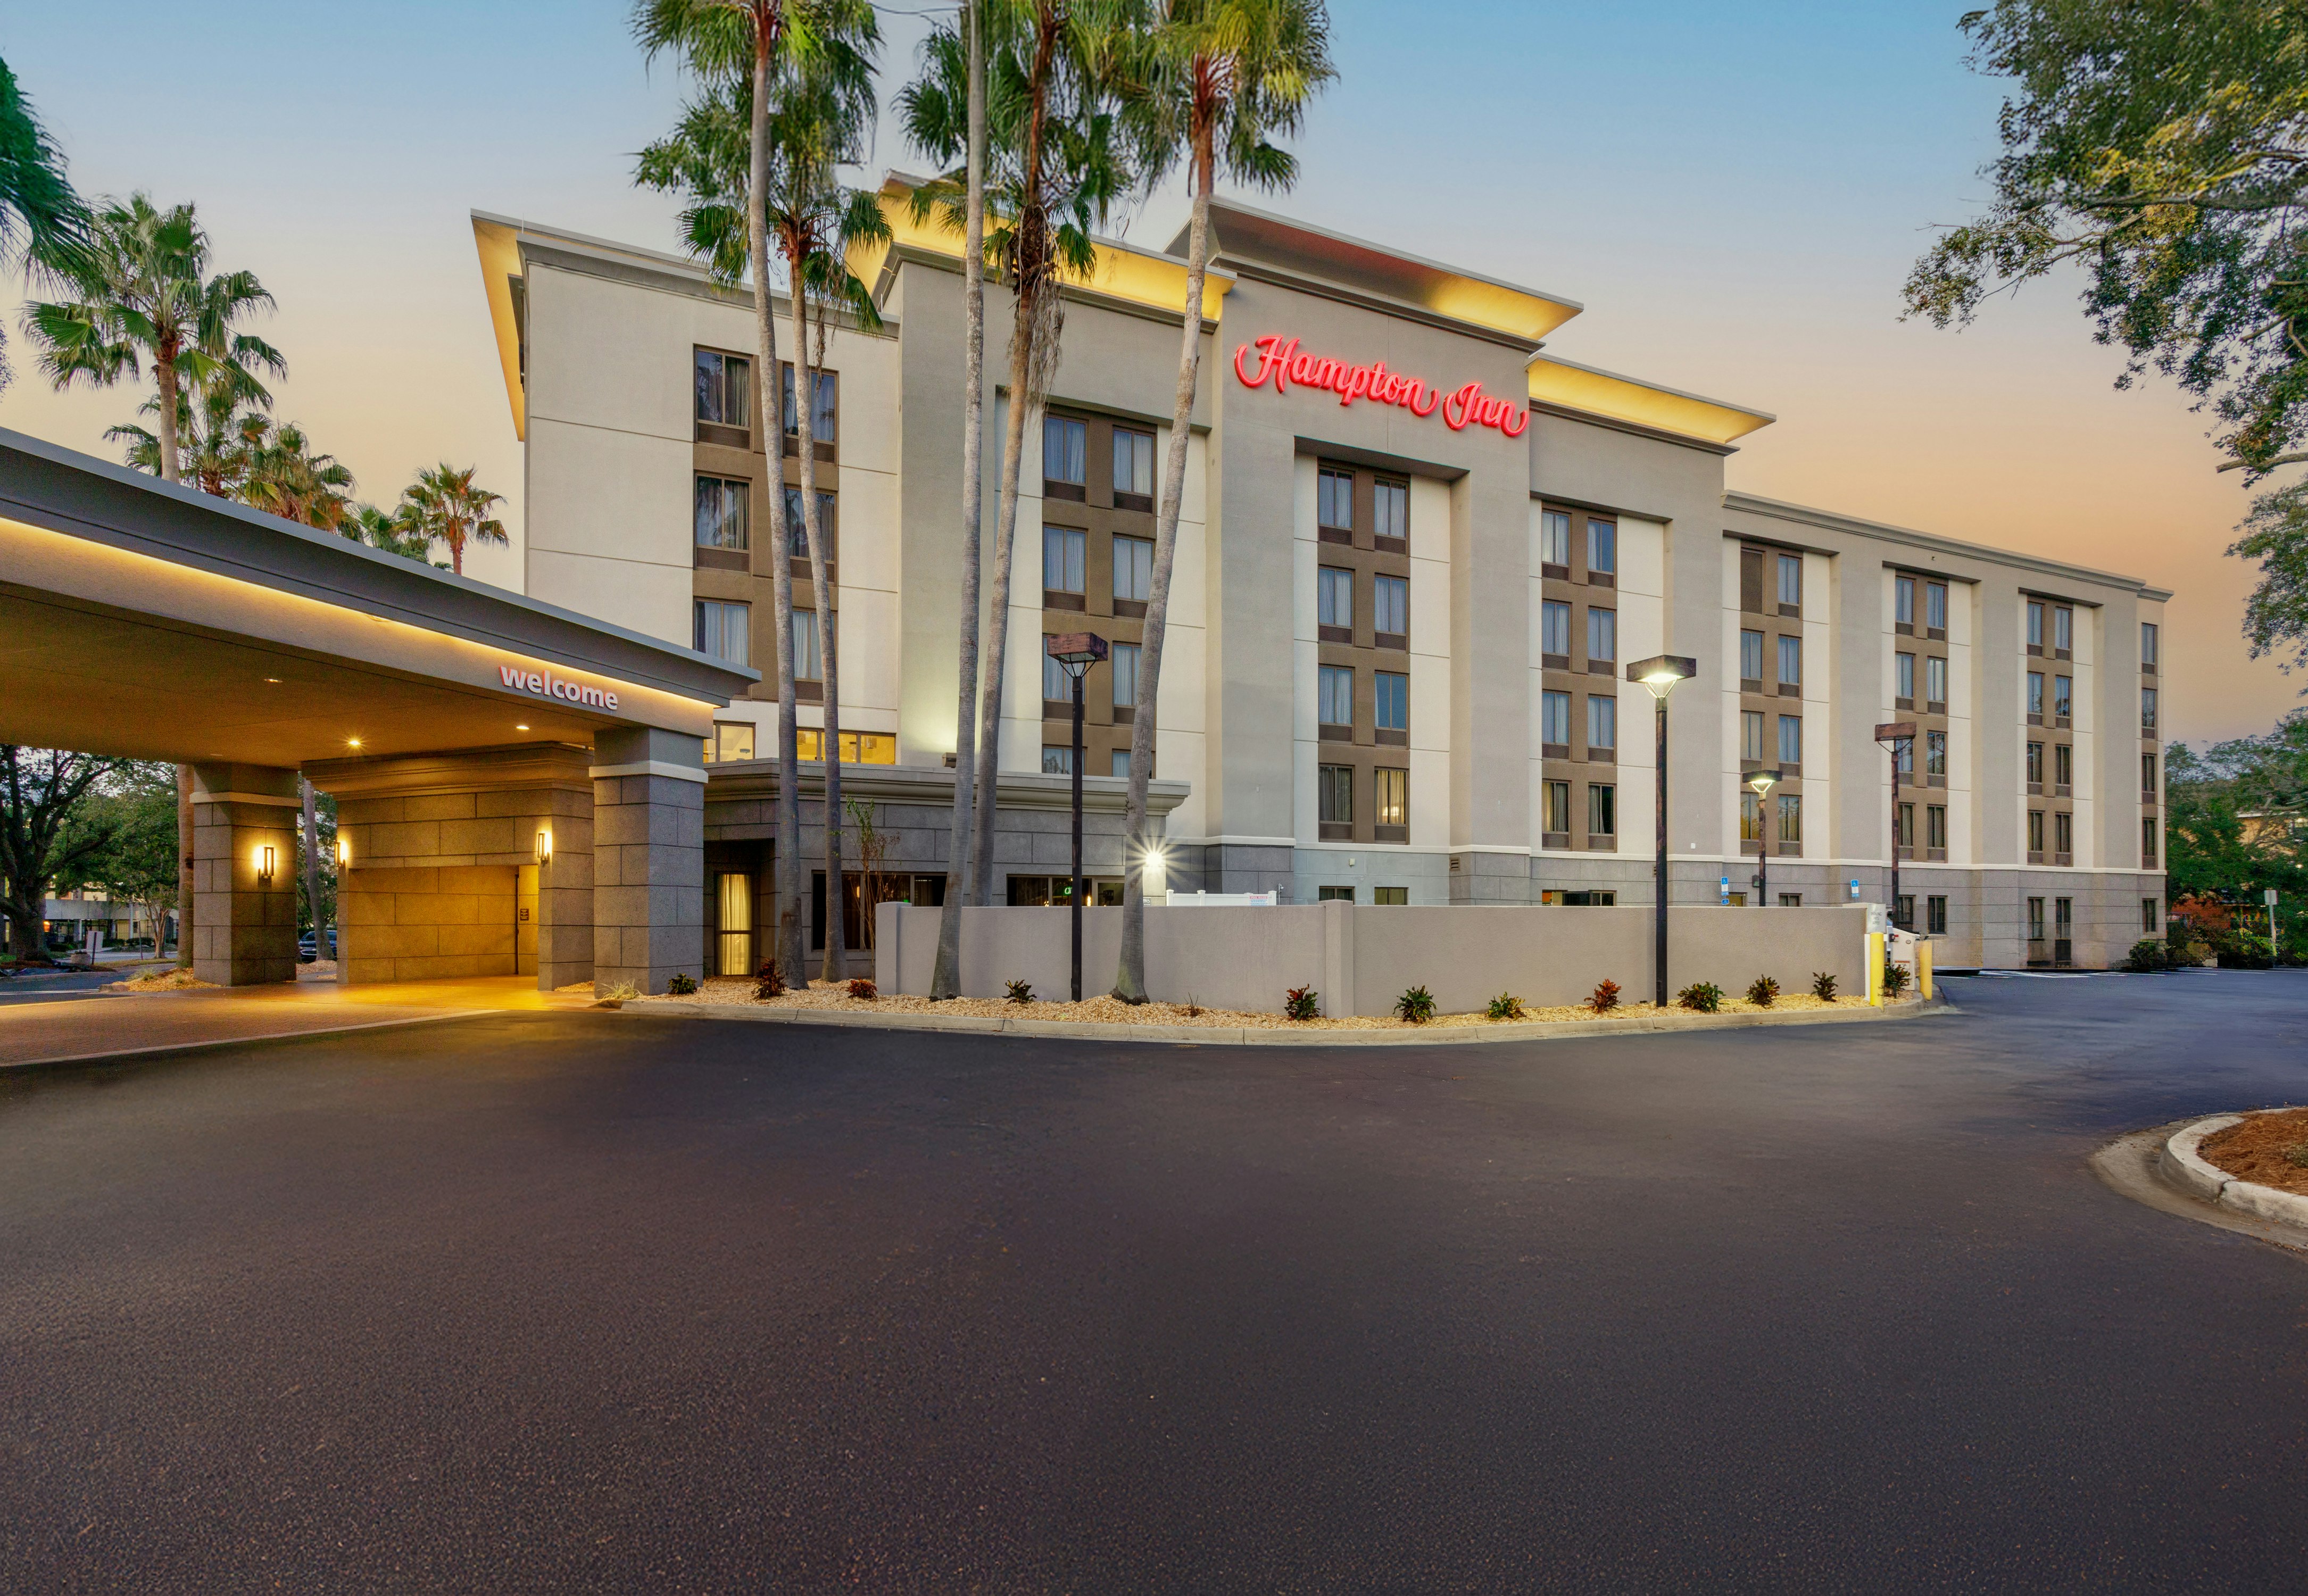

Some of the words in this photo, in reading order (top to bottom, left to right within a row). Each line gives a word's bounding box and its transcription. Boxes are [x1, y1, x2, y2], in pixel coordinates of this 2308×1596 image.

[1235, 335, 1439, 416] Hampton
[1443, 383, 1528, 437] Inn
[499, 666, 618, 710] welcome
